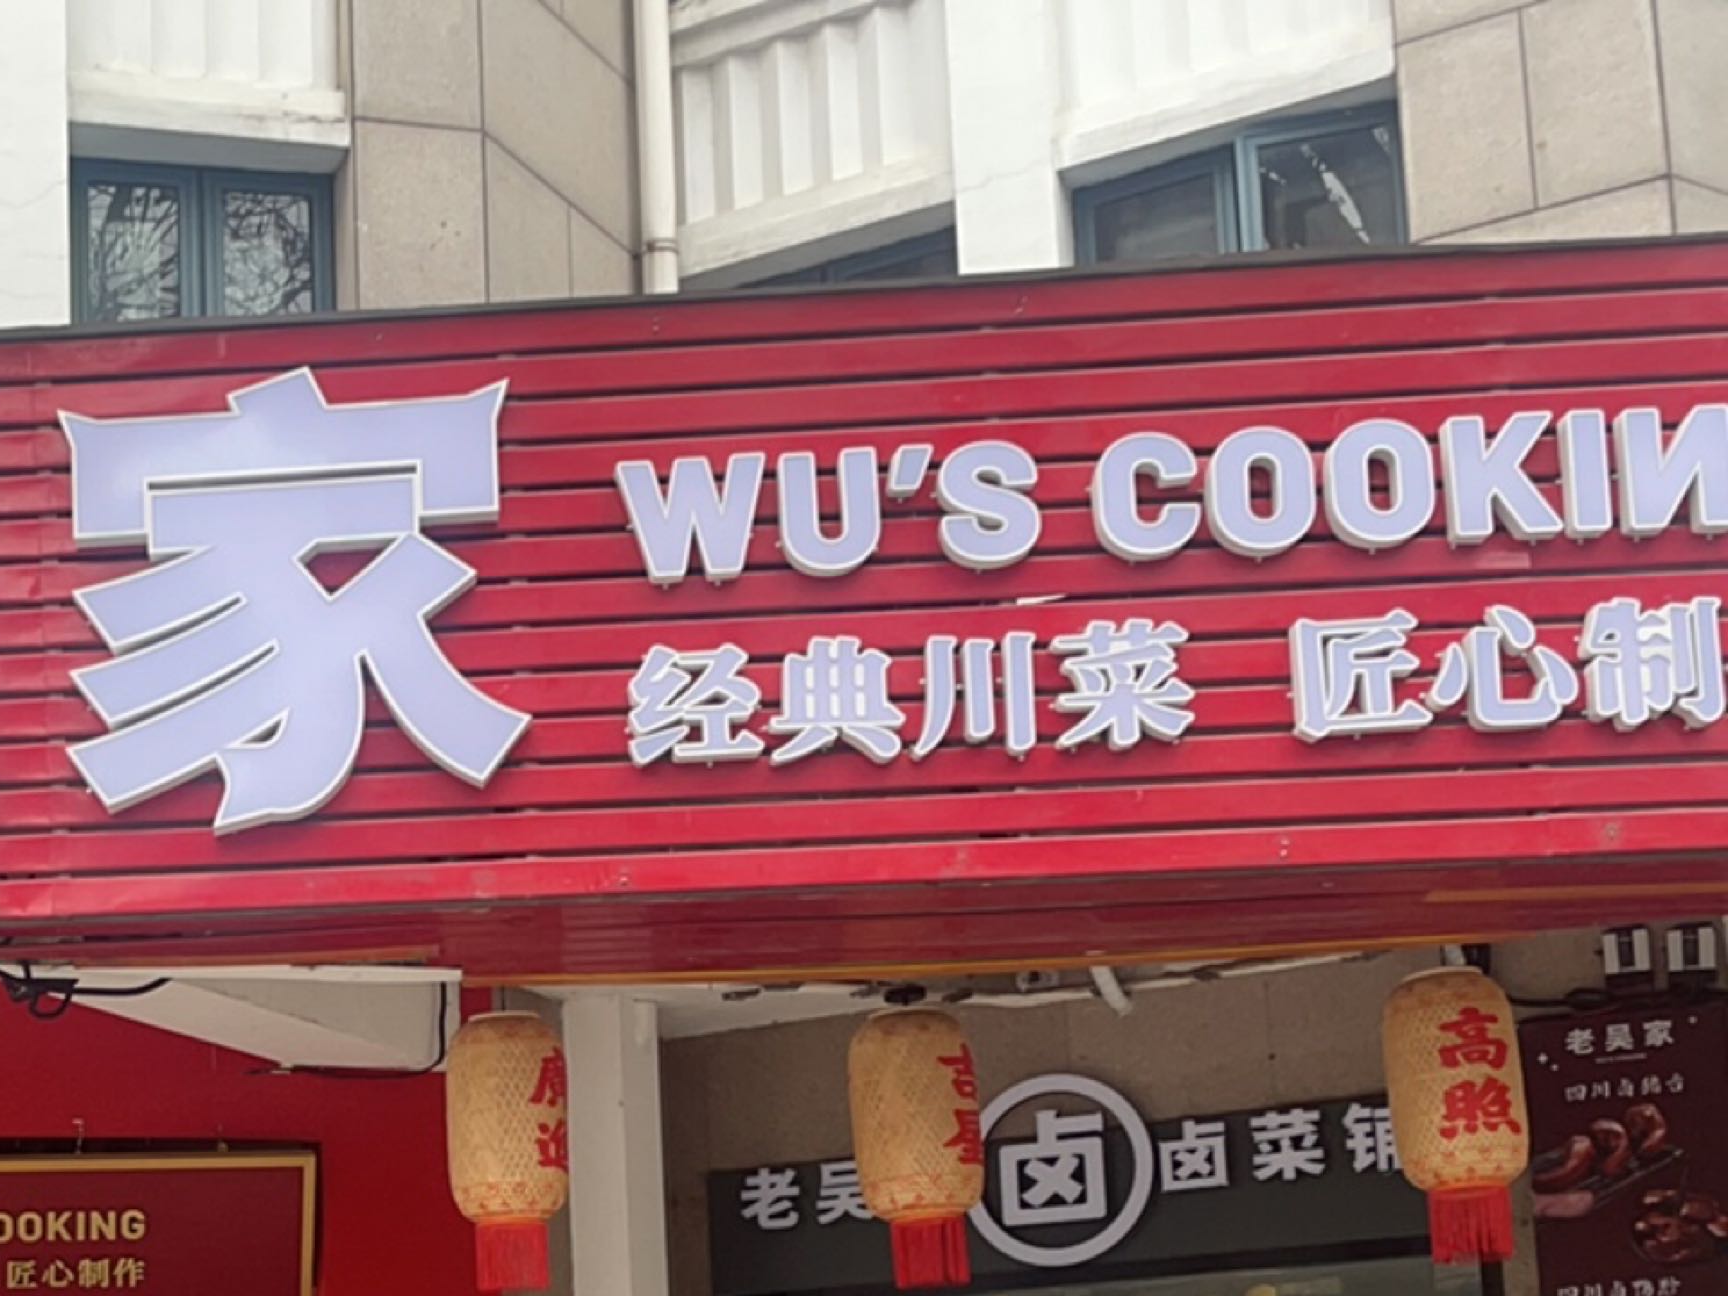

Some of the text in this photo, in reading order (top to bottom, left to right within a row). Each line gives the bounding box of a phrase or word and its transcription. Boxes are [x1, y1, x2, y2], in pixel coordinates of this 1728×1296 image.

[615, 438, 1043, 586] WU'S
[627, 596, 1723, 768] 经典川菜 匠心制
[1438, 1006, 1522, 1140] 高照
[1565, 1019, 1674, 1056] 老吴家
[739, 1161, 872, 1231] 老吴
[998, 1109, 1108, 1227] 卤
[1158, 1100, 1406, 1194] 卤菜铺
[5, 1255, 146, 1290] 匠心制作
